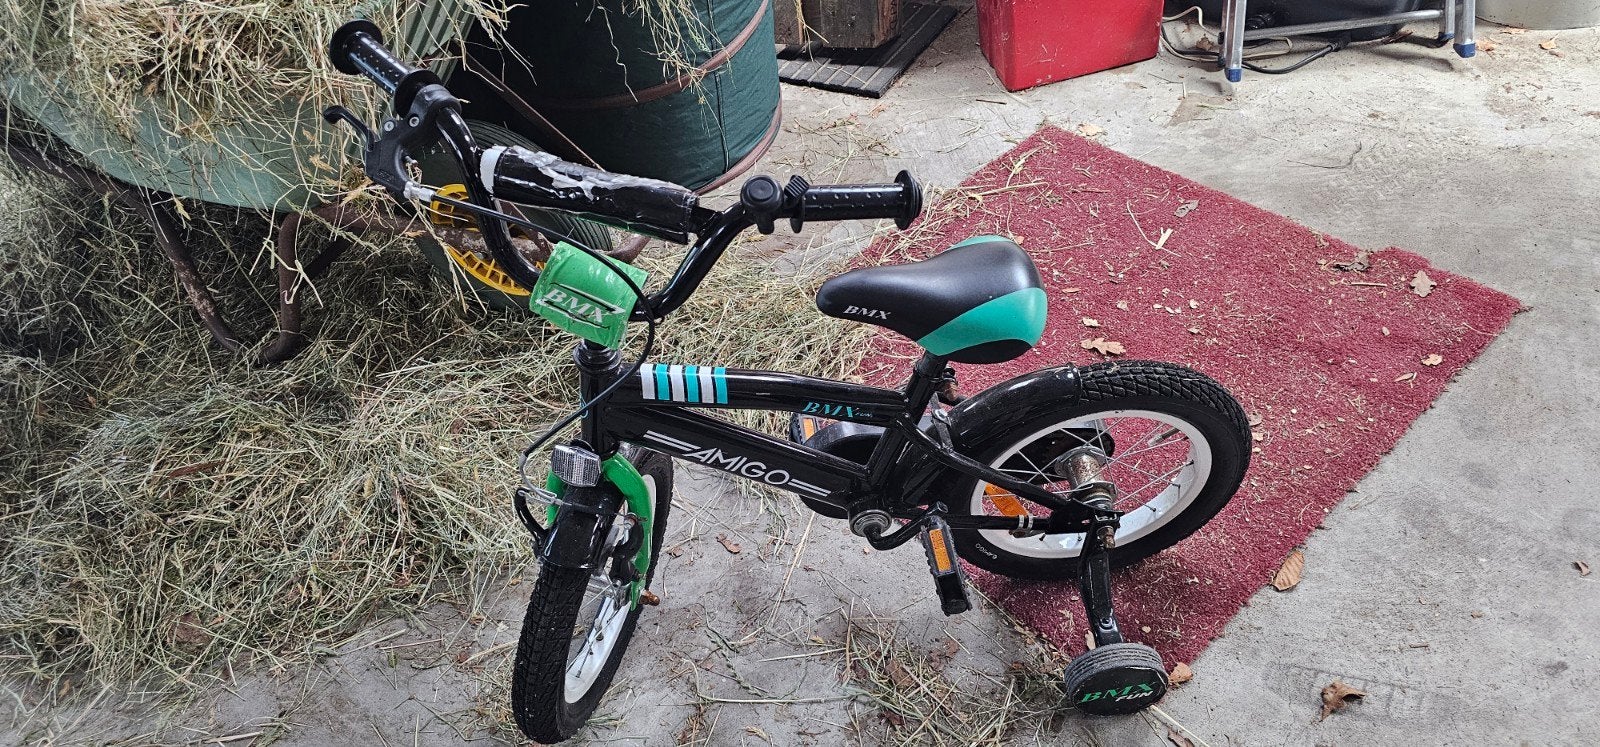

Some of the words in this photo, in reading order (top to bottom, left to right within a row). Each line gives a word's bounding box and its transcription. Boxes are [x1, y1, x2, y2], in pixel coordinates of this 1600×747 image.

[545, 288, 613, 323] BMX
[842, 305, 892, 320] BMX
[802, 401, 859, 418] BMX
[682, 447, 790, 485] AMIGO
[1078, 681, 1156, 703] BMX
[1115, 690, 1154, 702] FUN
